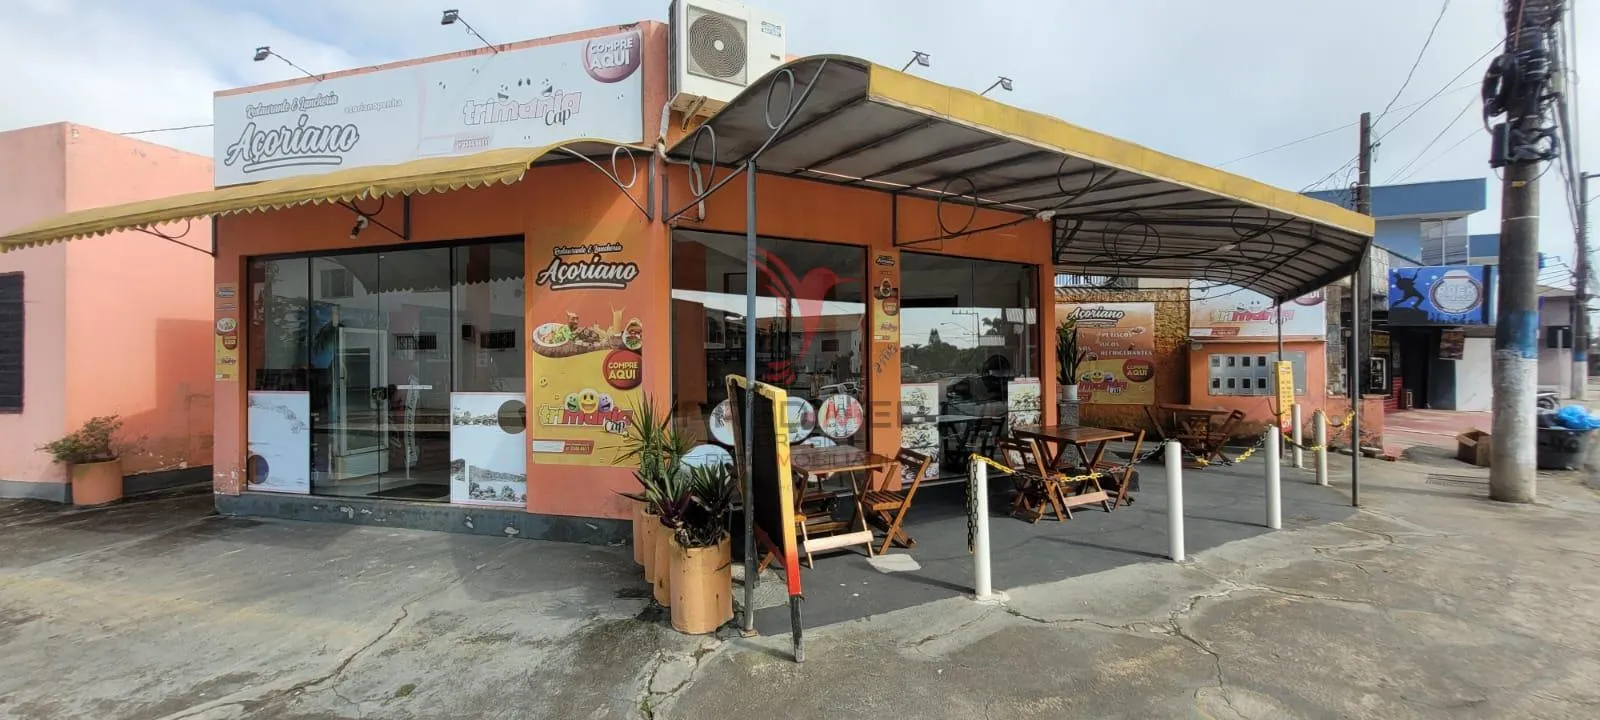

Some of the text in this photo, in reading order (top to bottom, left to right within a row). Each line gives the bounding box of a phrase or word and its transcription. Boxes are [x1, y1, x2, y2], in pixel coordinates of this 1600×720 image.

[590, 36, 633, 55] COMPRE
[591, 49, 630, 70] AQUI
[462, 89, 582, 125] trimania
[544, 108, 571, 126] Cap
[224, 113, 360, 166] Açoriano
[537, 255, 639, 285] Açoriano
[1067, 306, 1125, 321] Açoriano
[608, 361, 639, 369] COMPRE
[608, 369, 636, 380] AQUI
[539, 403, 634, 427] trimania
